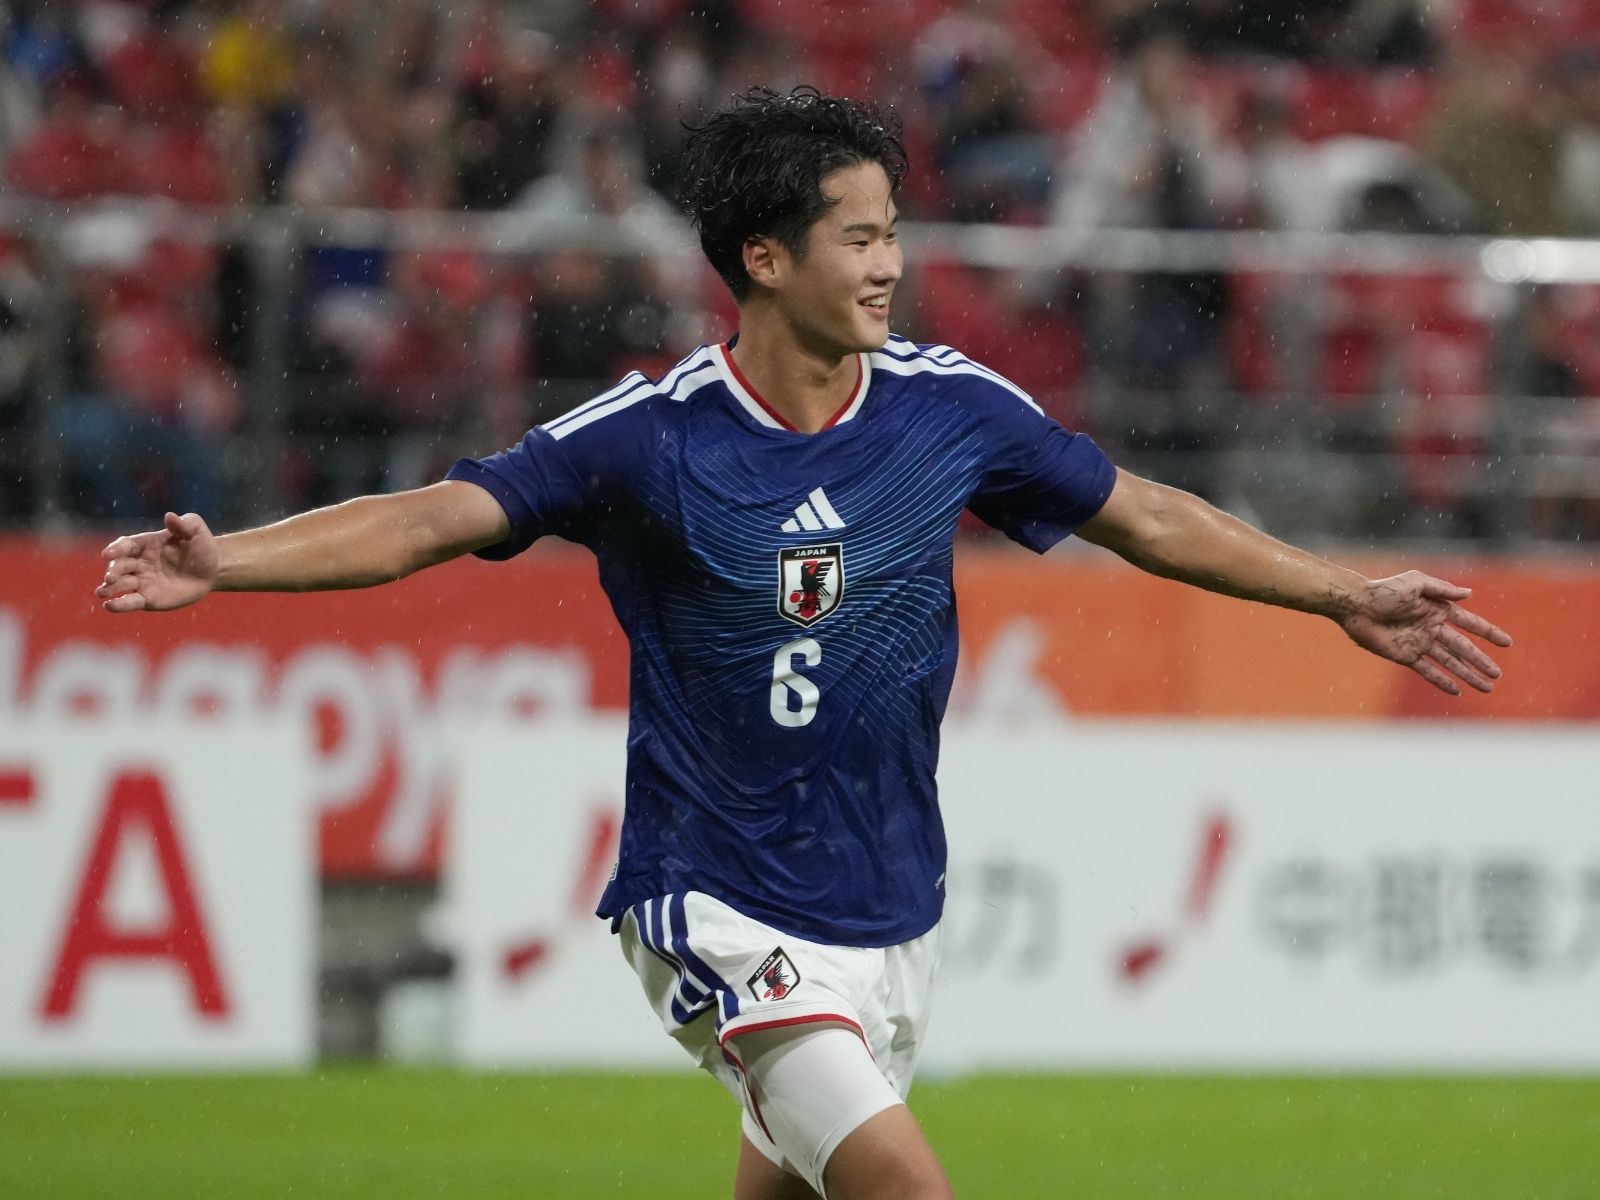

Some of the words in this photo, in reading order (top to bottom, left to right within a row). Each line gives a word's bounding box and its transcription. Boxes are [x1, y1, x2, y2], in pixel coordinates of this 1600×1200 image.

[794, 548, 827, 557] JAPAN
[770, 637, 822, 727] 6
[755, 955, 776, 979] JAPAN
